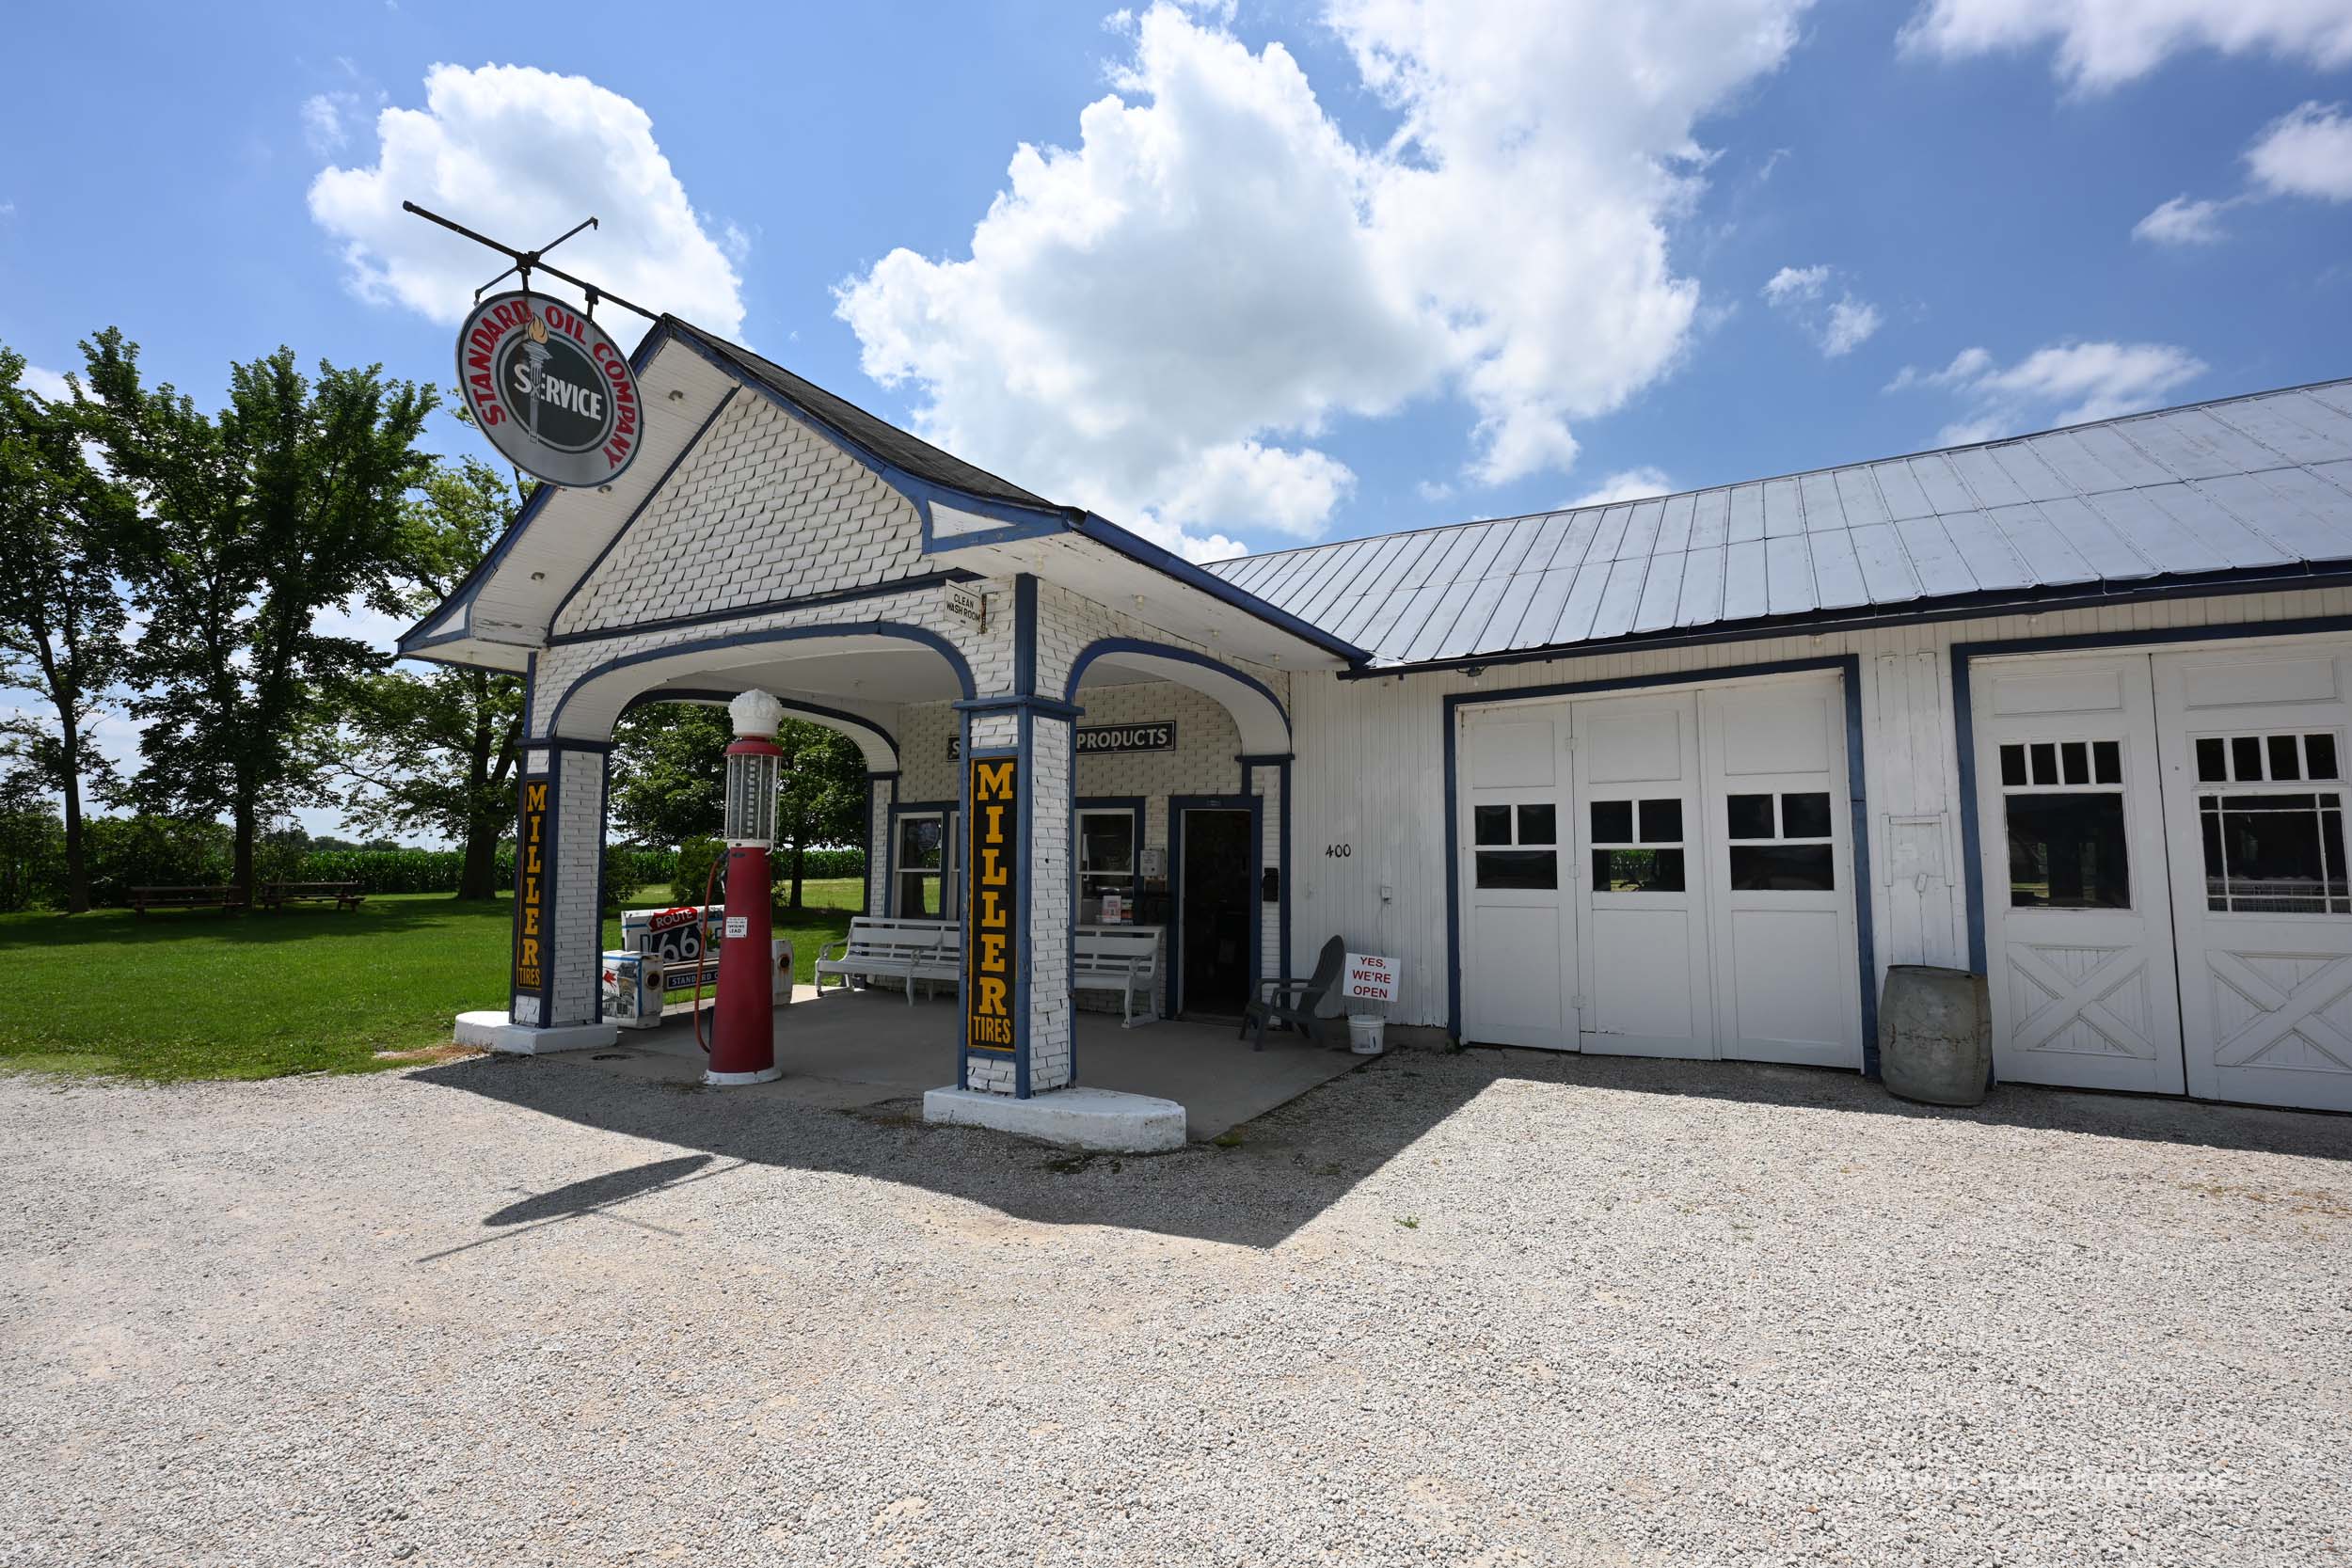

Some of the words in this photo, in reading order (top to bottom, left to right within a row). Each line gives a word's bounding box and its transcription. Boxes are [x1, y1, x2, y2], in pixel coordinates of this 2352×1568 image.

[469, 300, 533, 426] STANDARD
[545, 305, 588, 346] OIL
[593, 341, 637, 468] COMPANY
[954, 594, 974, 610] CLEAN
[1076, 728, 1168, 750] PRODUCTS
[1325, 844, 1352, 858] 400
[522, 784, 548, 966] MILLER
[977, 762, 1014, 1016] MILLER
[656, 909, 693, 927] ROUTE
[659, 927, 700, 964] 66
[1360, 956, 1387, 970] YES,
[518, 967, 541, 987] TIRES
[672, 973, 712, 986] STANDRD
[1352, 970, 1392, 984] WE'RE
[1353, 985, 1389, 999] OPEN
[973, 1016, 1011, 1045] TIRES
